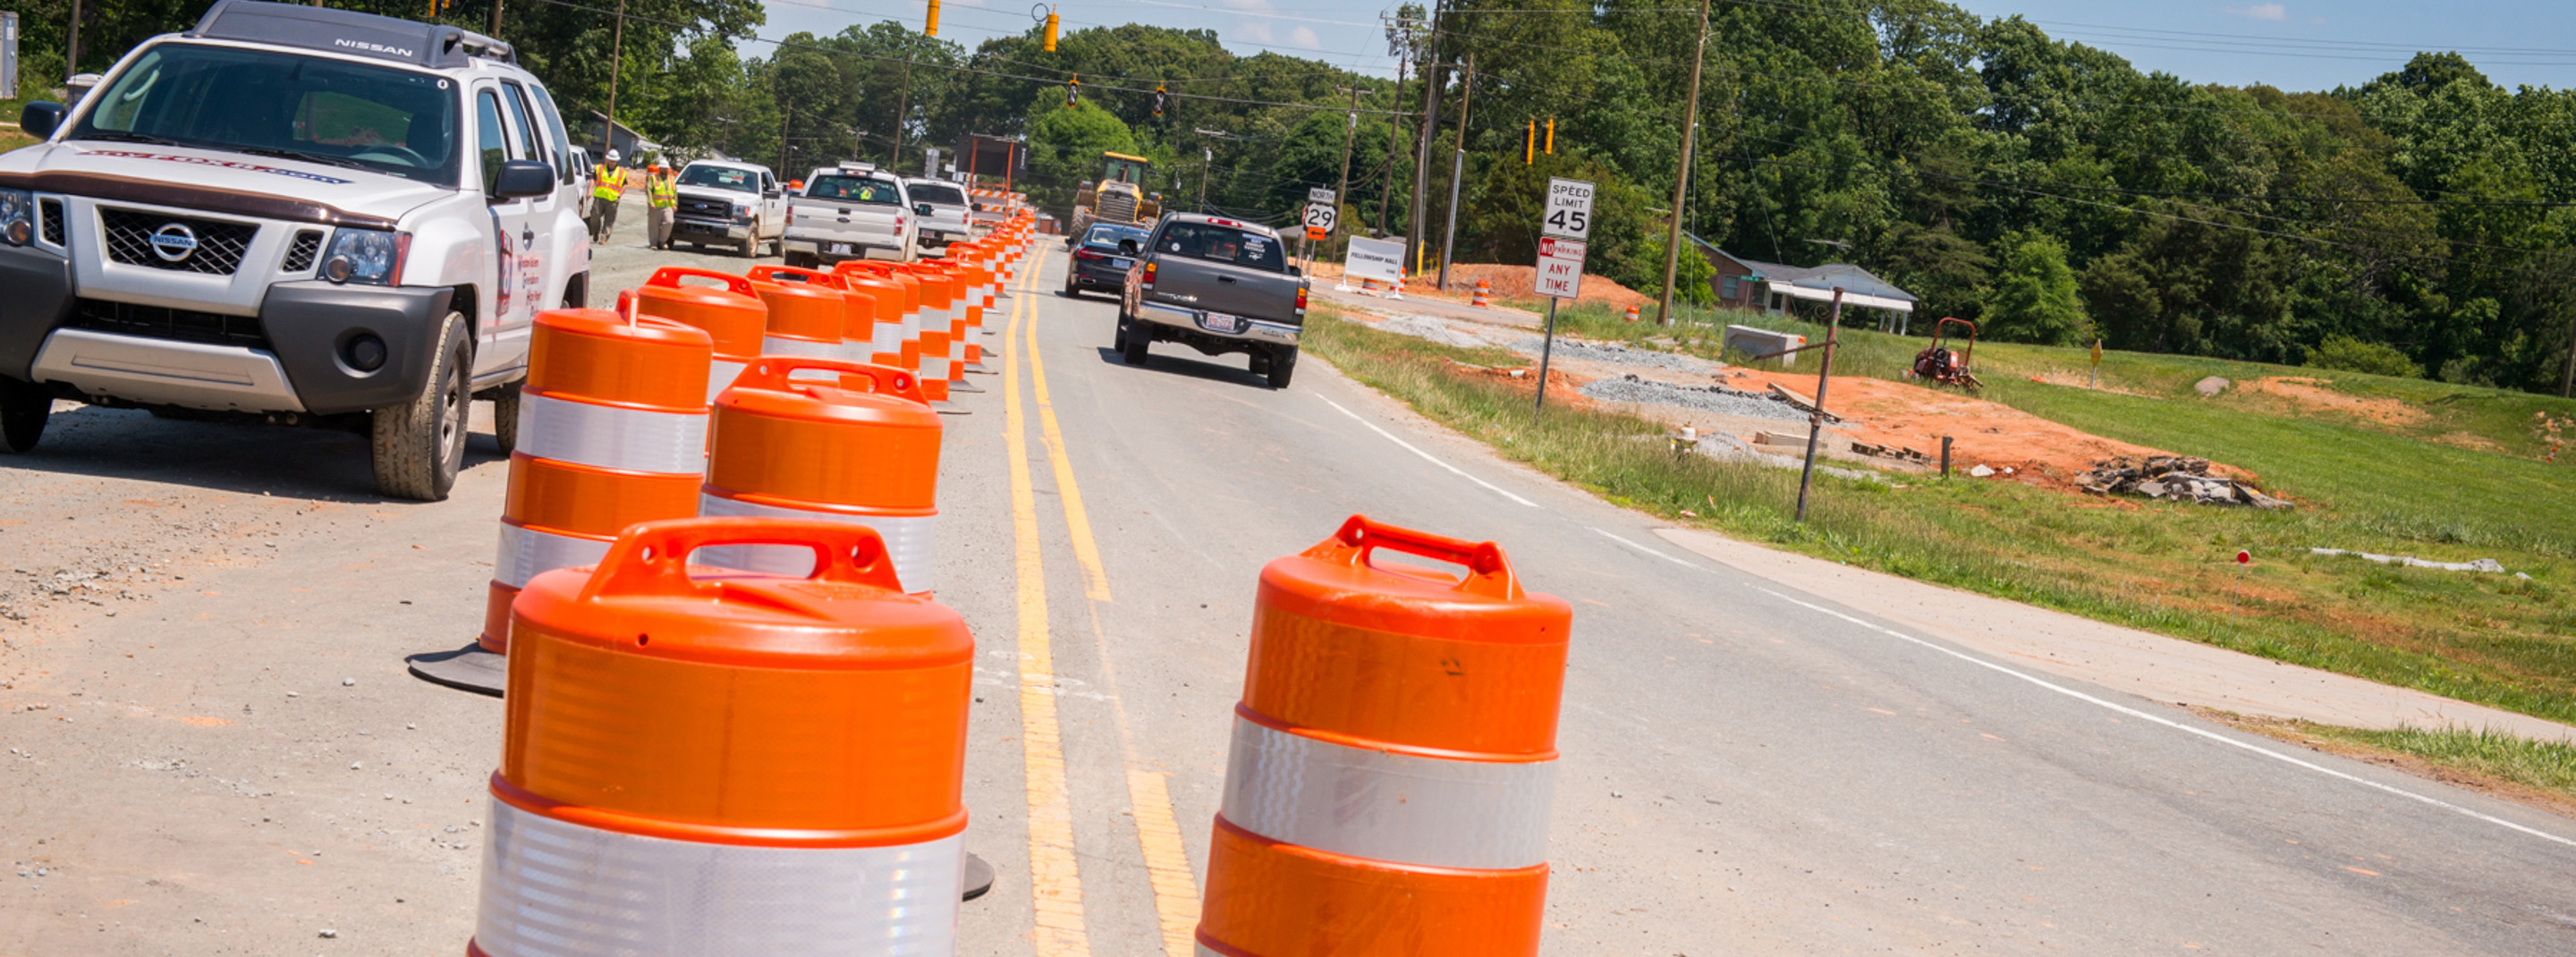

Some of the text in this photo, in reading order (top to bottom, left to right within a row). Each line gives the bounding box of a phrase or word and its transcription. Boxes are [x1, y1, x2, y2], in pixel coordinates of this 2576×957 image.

[335, 38, 412, 57] NISSAN
[1311, 190, 1334, 200] NORTH
[1552, 184, 1590, 198] SPEED
[1555, 197, 1584, 208] LIMIT
[1308, 208, 1332, 226] 29
[1547, 209, 1585, 232] 45
[154, 236, 192, 246] NISSAN
[1541, 241, 1582, 257] NO PARKING
[1351, 251, 1398, 266] FELLOWSHIP HALL
[1548, 263, 1571, 275] ANY
[1546, 277, 1569, 292] TIME
